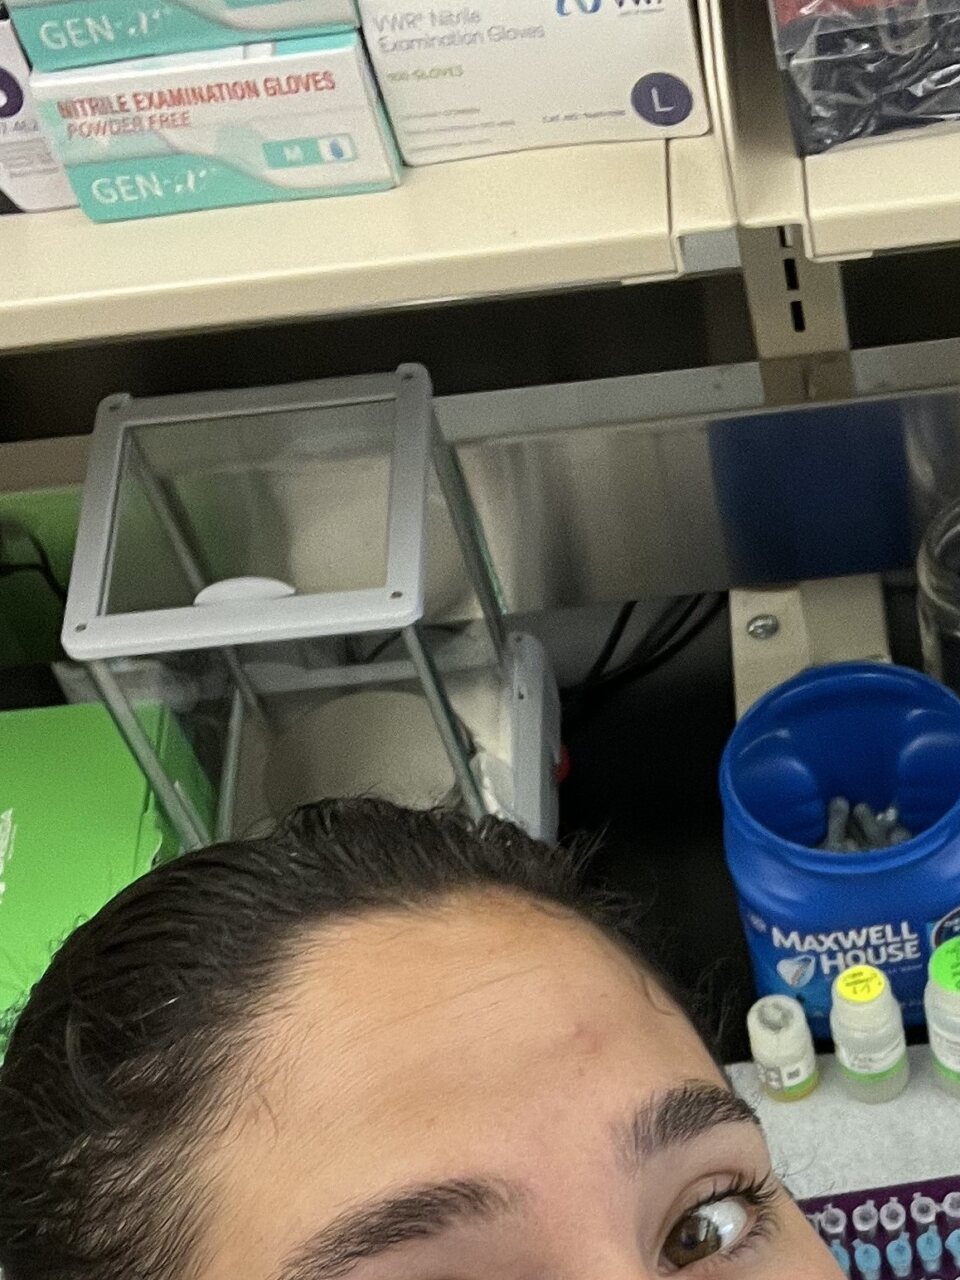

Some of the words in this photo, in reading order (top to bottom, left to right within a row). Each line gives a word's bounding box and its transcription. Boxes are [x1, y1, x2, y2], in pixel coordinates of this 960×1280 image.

[487, 23, 546, 43] Gloves
[56, 95, 131, 119] NITRILE
[132, 79, 261, 113] EXAMINATION
[262, 70, 337, 98] GLOVES
[650, 86, 675, 113] L
[67, 116, 145, 140] POWDER
[148, 112, 192, 129] FREE
[771, 921, 919, 952] MAXWELL
[820, 939, 922, 975] HOUSE
